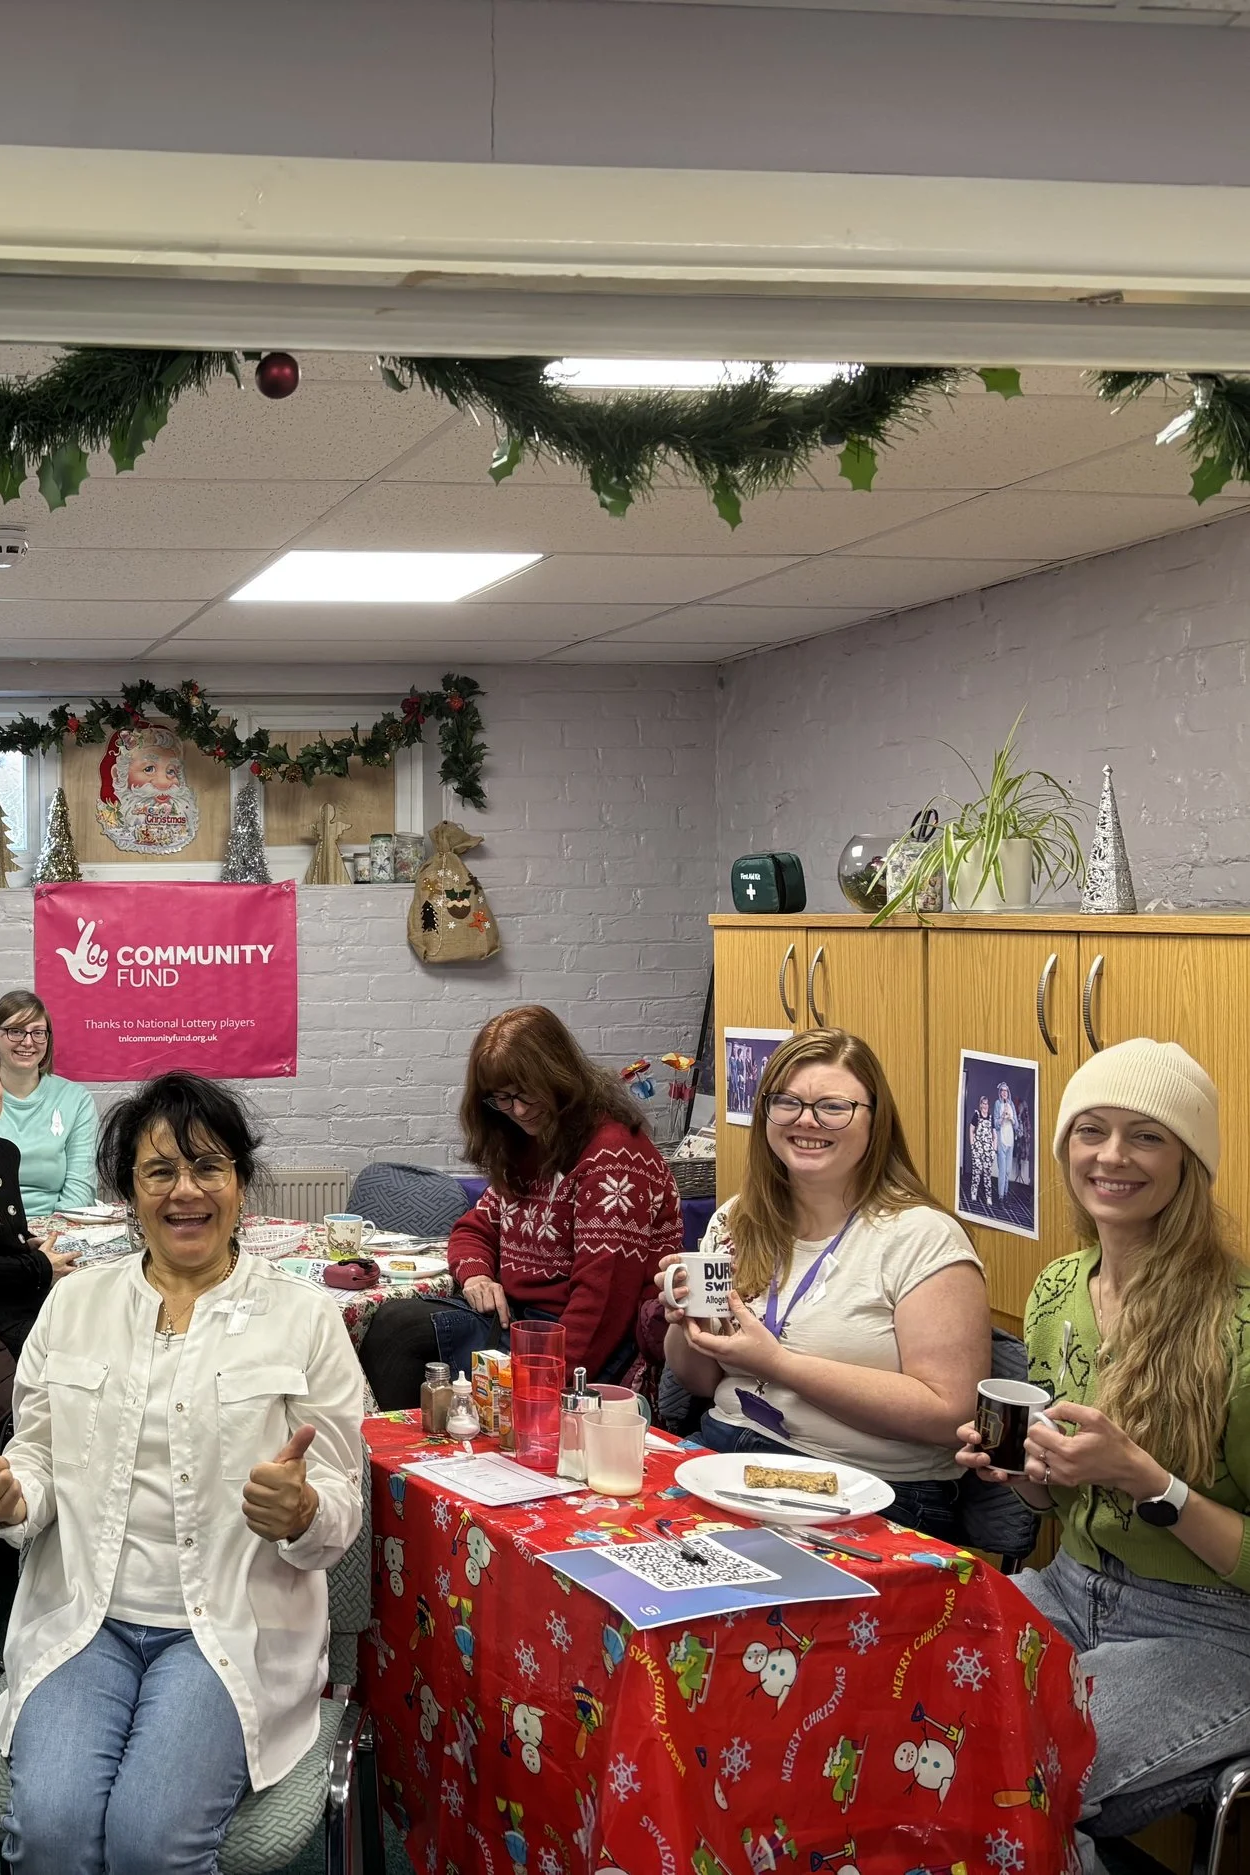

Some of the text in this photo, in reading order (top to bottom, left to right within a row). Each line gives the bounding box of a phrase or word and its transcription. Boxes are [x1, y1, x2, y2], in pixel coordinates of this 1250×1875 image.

[146, 814, 187, 825] Christmas
[116, 944, 275, 966] COMMUNITY
[116, 968, 179, 988] FUND
[84, 1017, 256, 1031] Thanks to National Lottery players
[118, 1033, 219, 1043] tnlcommunityfund.org.uk
[703, 1262, 731, 1280] DUR
[892, 1587, 956, 1700] MERRY CHRISTMAS
[628, 1644, 687, 1777] MERRY CHRISTMAS
[781, 1665, 847, 1783] MERRY CHRISTMAS
